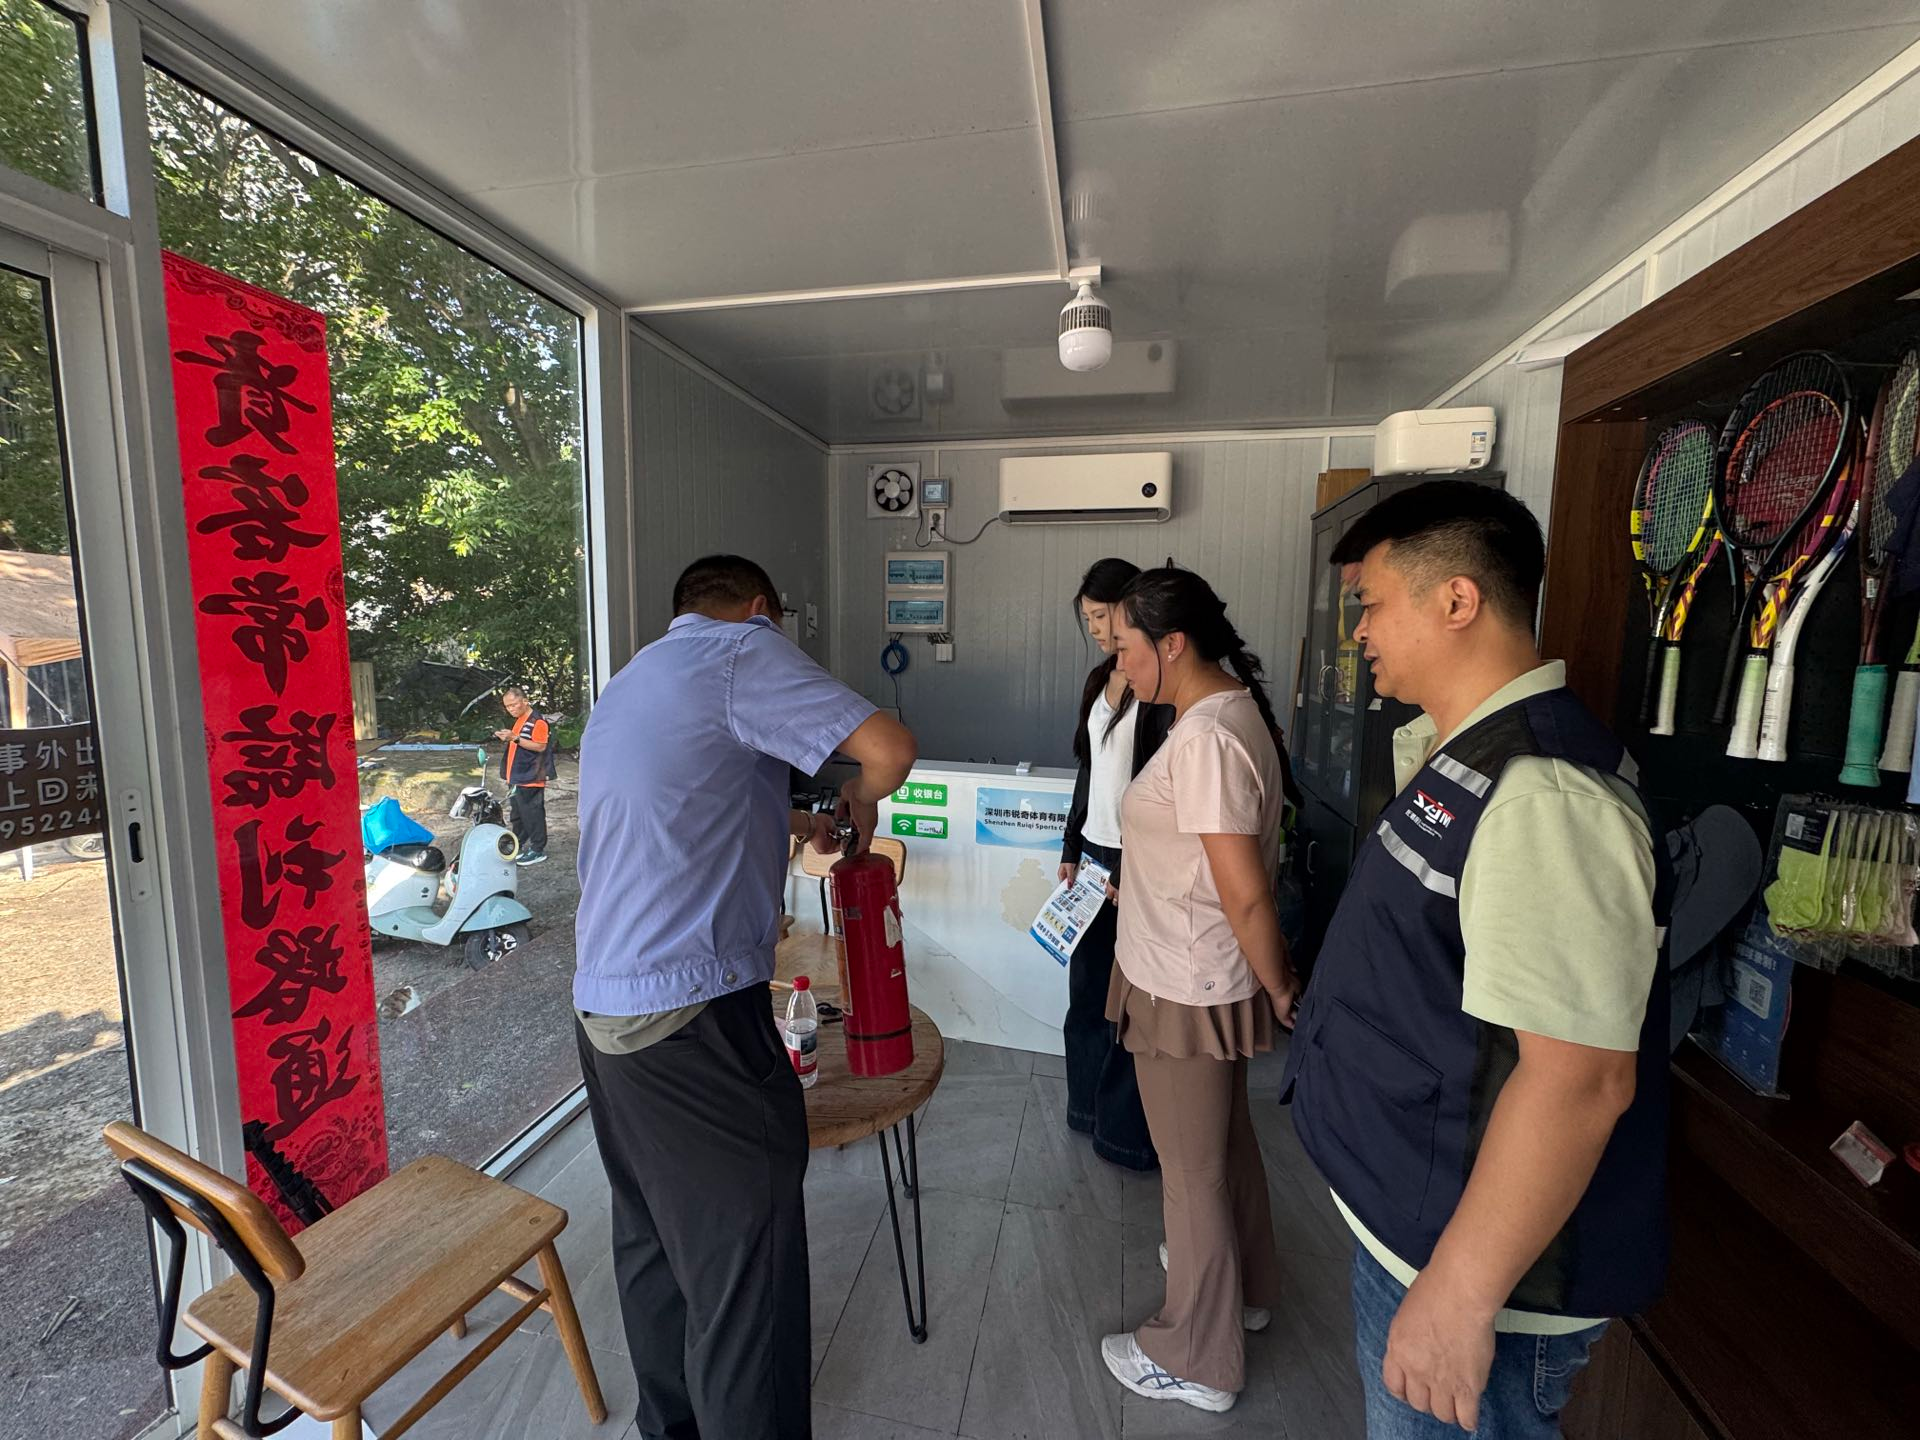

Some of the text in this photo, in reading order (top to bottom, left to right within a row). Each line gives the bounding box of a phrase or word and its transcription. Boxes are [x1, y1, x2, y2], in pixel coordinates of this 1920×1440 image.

[913, 788, 943, 800] 收银台
[984, 807, 1068, 823] 深圳市锐奇体育有限
[984, 818, 1016, 827] Shenzhen
[1035, 823, 1057, 831] Sports
